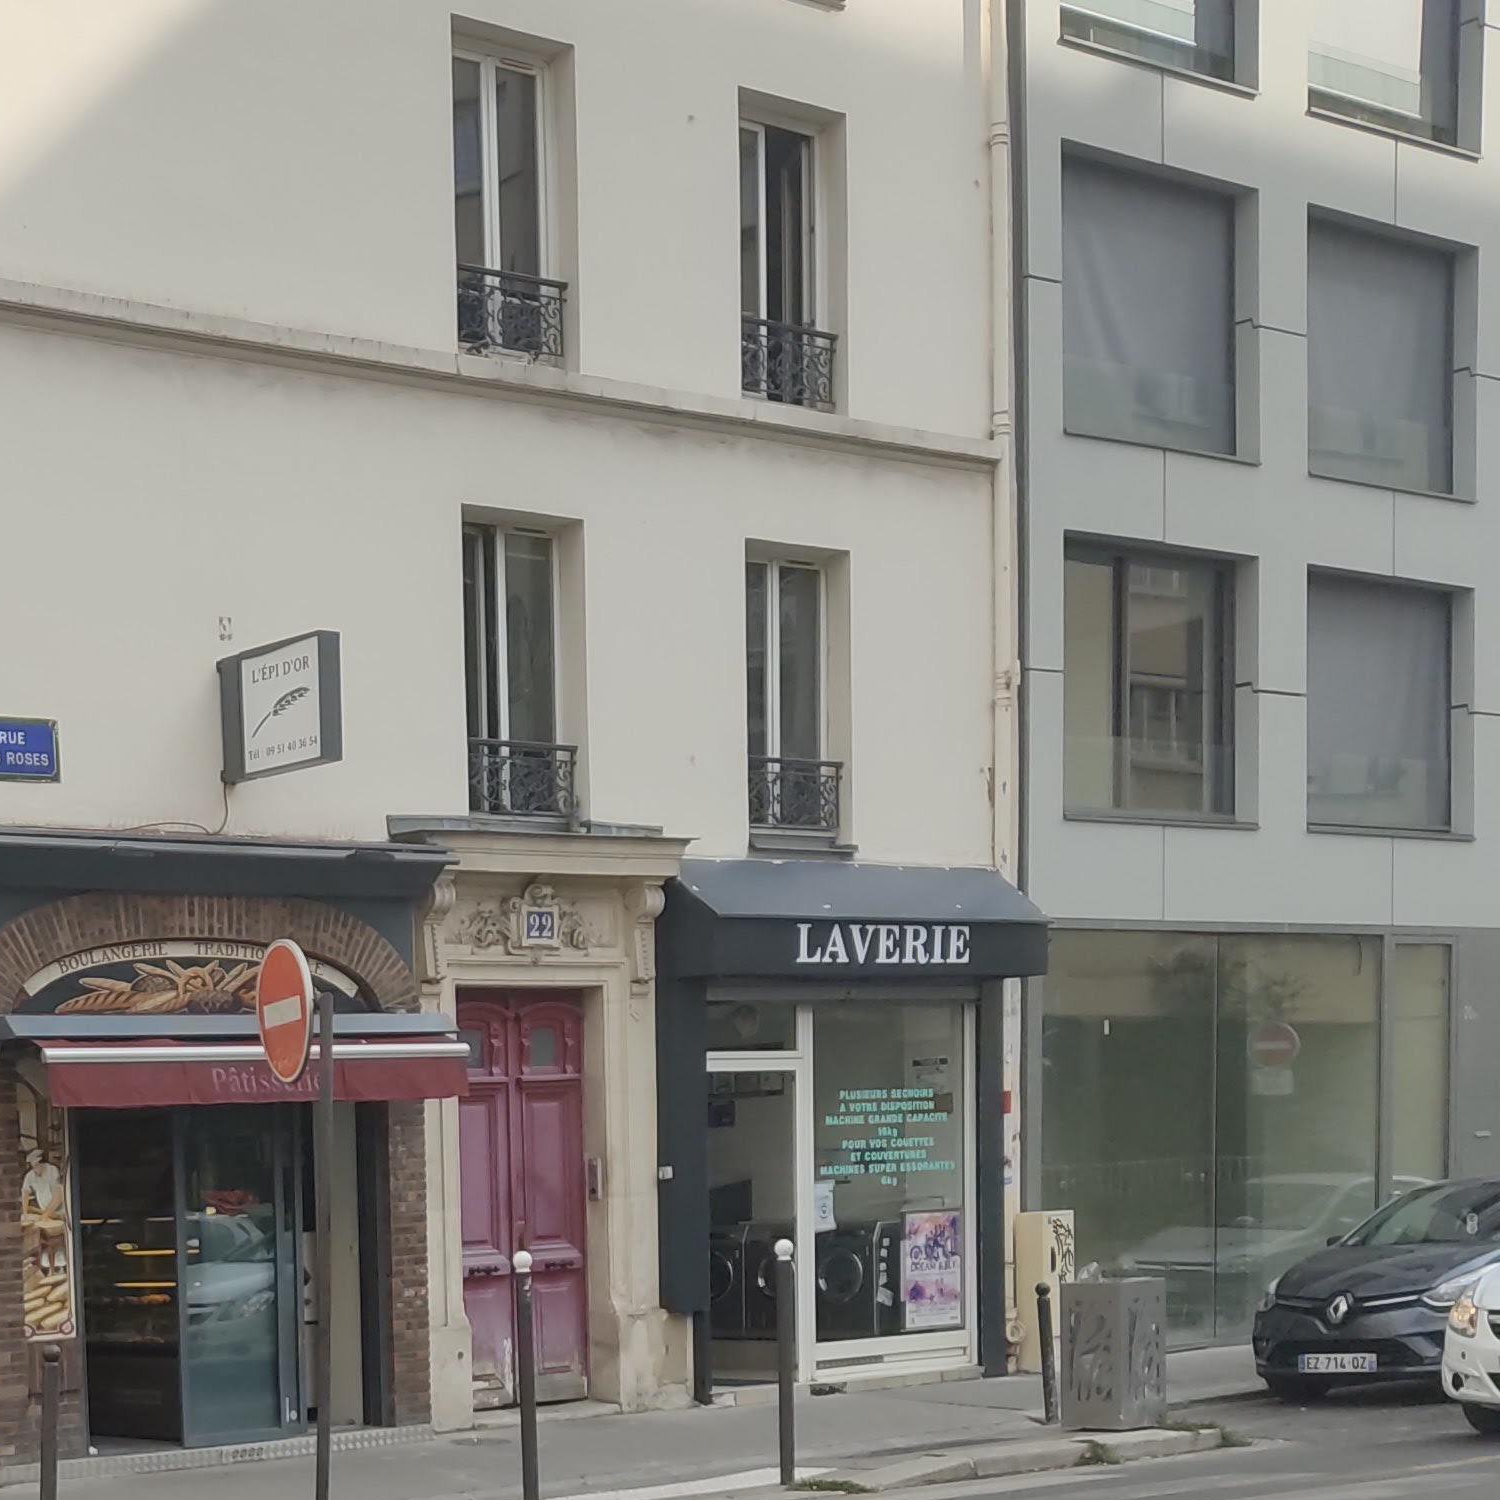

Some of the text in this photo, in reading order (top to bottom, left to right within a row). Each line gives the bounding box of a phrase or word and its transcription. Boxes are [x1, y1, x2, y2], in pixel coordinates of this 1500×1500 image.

[252, 655, 309, 684] L'ÉPI D'OR
[266, 745, 274, 757] 09
[277, 743, 285, 754] 51
[287, 741, 296, 751] 40
[298, 738, 307, 749] 36
[309, 735, 318, 746] 54
[6, 751, 49, 766] ROSES
[529, 913, 552, 937] 22
[796, 923, 970, 965] LAVERIE
[58, 942, 168, 975] BOULANGERIE
[849, 1102, 877, 1112] VOTRE
[881, 1100, 935, 1112] DISPOSITION
[825, 1115, 865, 1125] MACHINE
[868, 1114, 903, 1124] GRANDE
[842, 1140, 866, 1149] POUR
[869, 1139, 887, 1148] VOS
[851, 1152, 861, 1162] ET
[820, 1164, 865, 1176] MACHINES
[869, 1163, 897, 1174] SUPER
